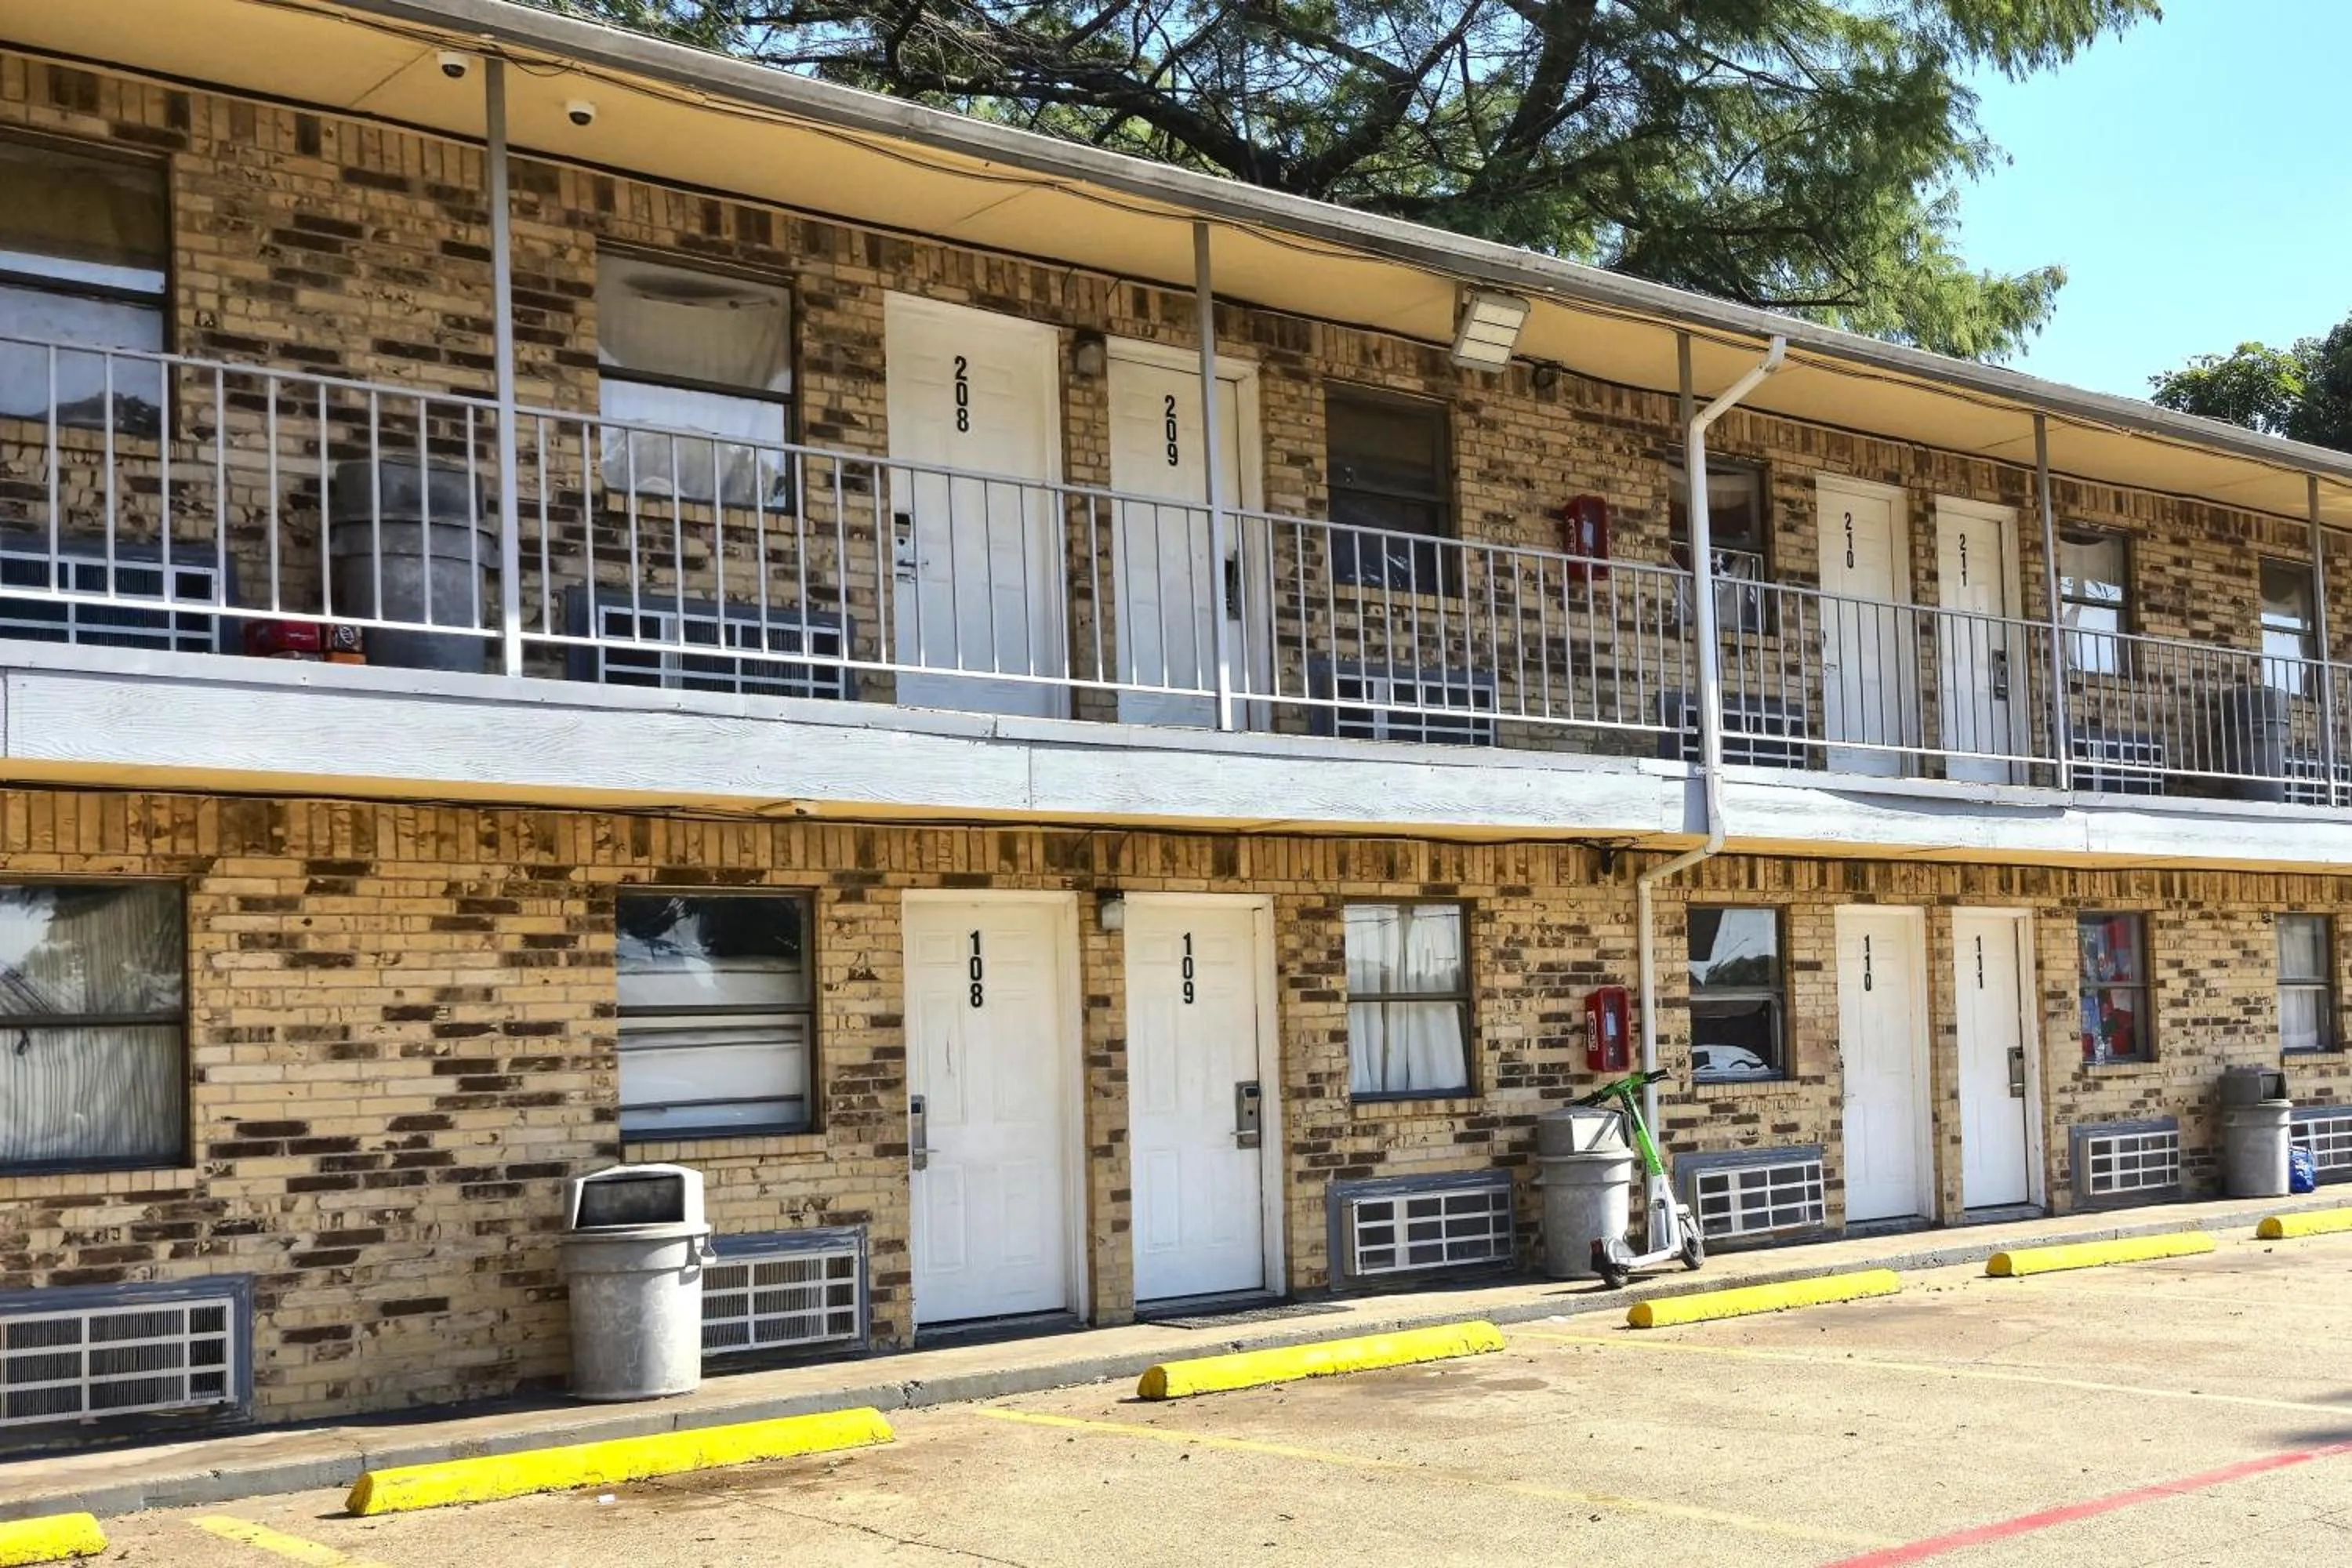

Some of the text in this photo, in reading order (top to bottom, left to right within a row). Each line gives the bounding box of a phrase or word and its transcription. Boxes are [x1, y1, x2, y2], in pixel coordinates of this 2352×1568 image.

[954, 355, 970, 433] 208
[1164, 394, 1178, 466] 209
[1844, 511, 1855, 569] 210
[1959, 532, 1968, 588] 211
[969, 930, 984, 1008] 108
[1181, 932, 1194, 1004] 109
[1864, 934, 1872, 992] 110
[1975, 935, 1984, 989] 111
